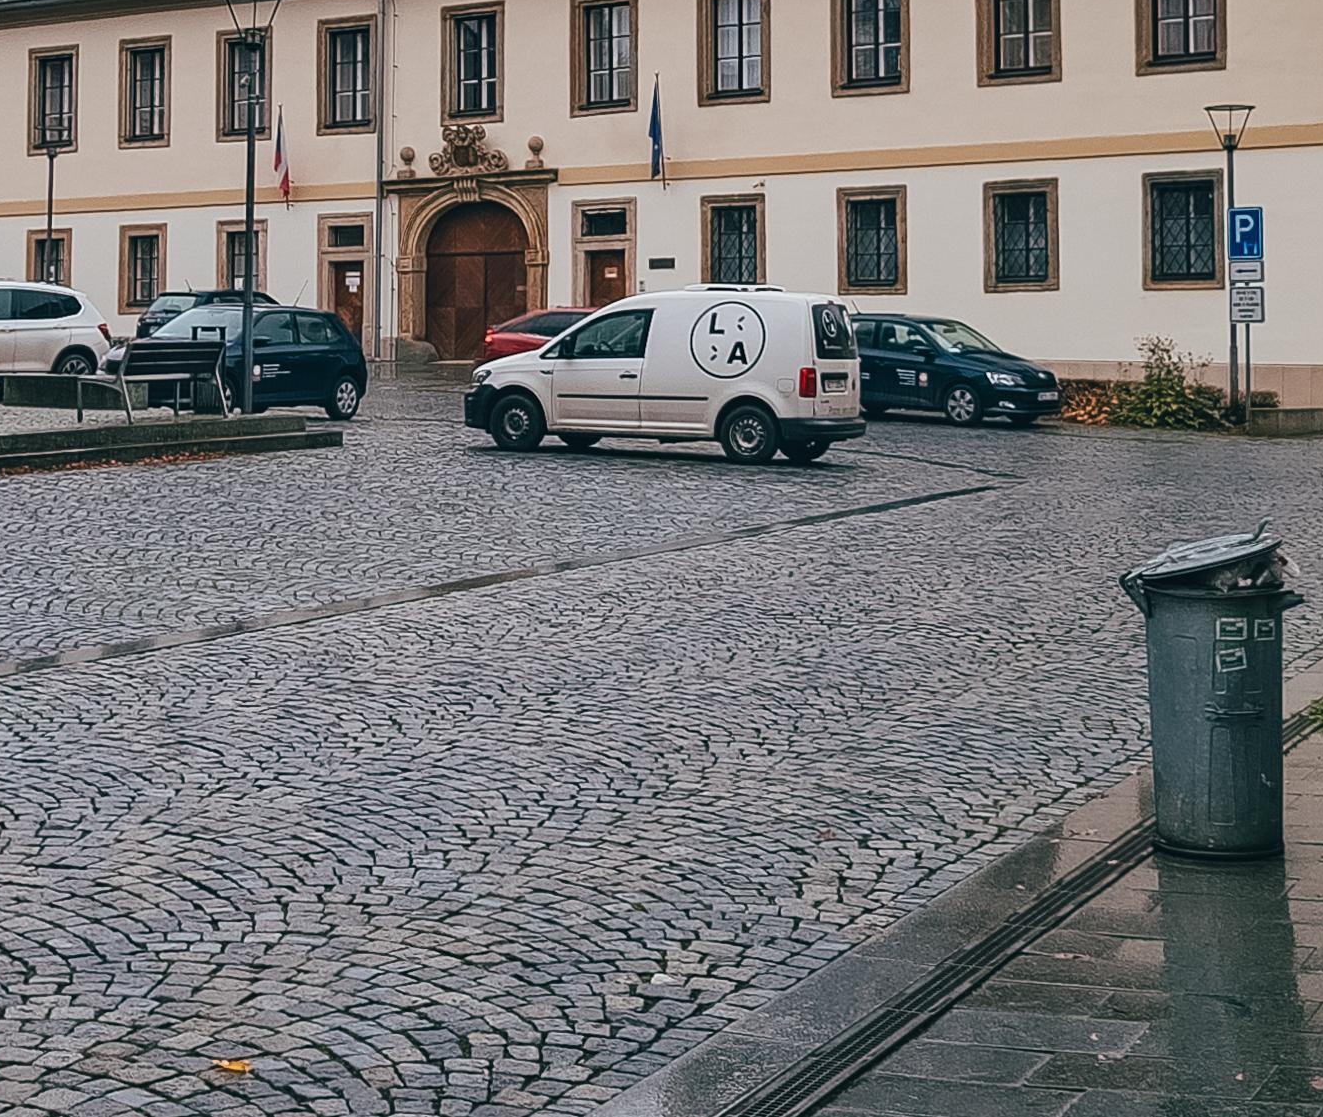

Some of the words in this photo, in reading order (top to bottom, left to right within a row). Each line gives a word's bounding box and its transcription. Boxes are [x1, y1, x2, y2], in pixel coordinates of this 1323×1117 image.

[1235, 213, 1255, 243] P
[709, 312, 725, 335] L
[727, 341, 748, 365] A
